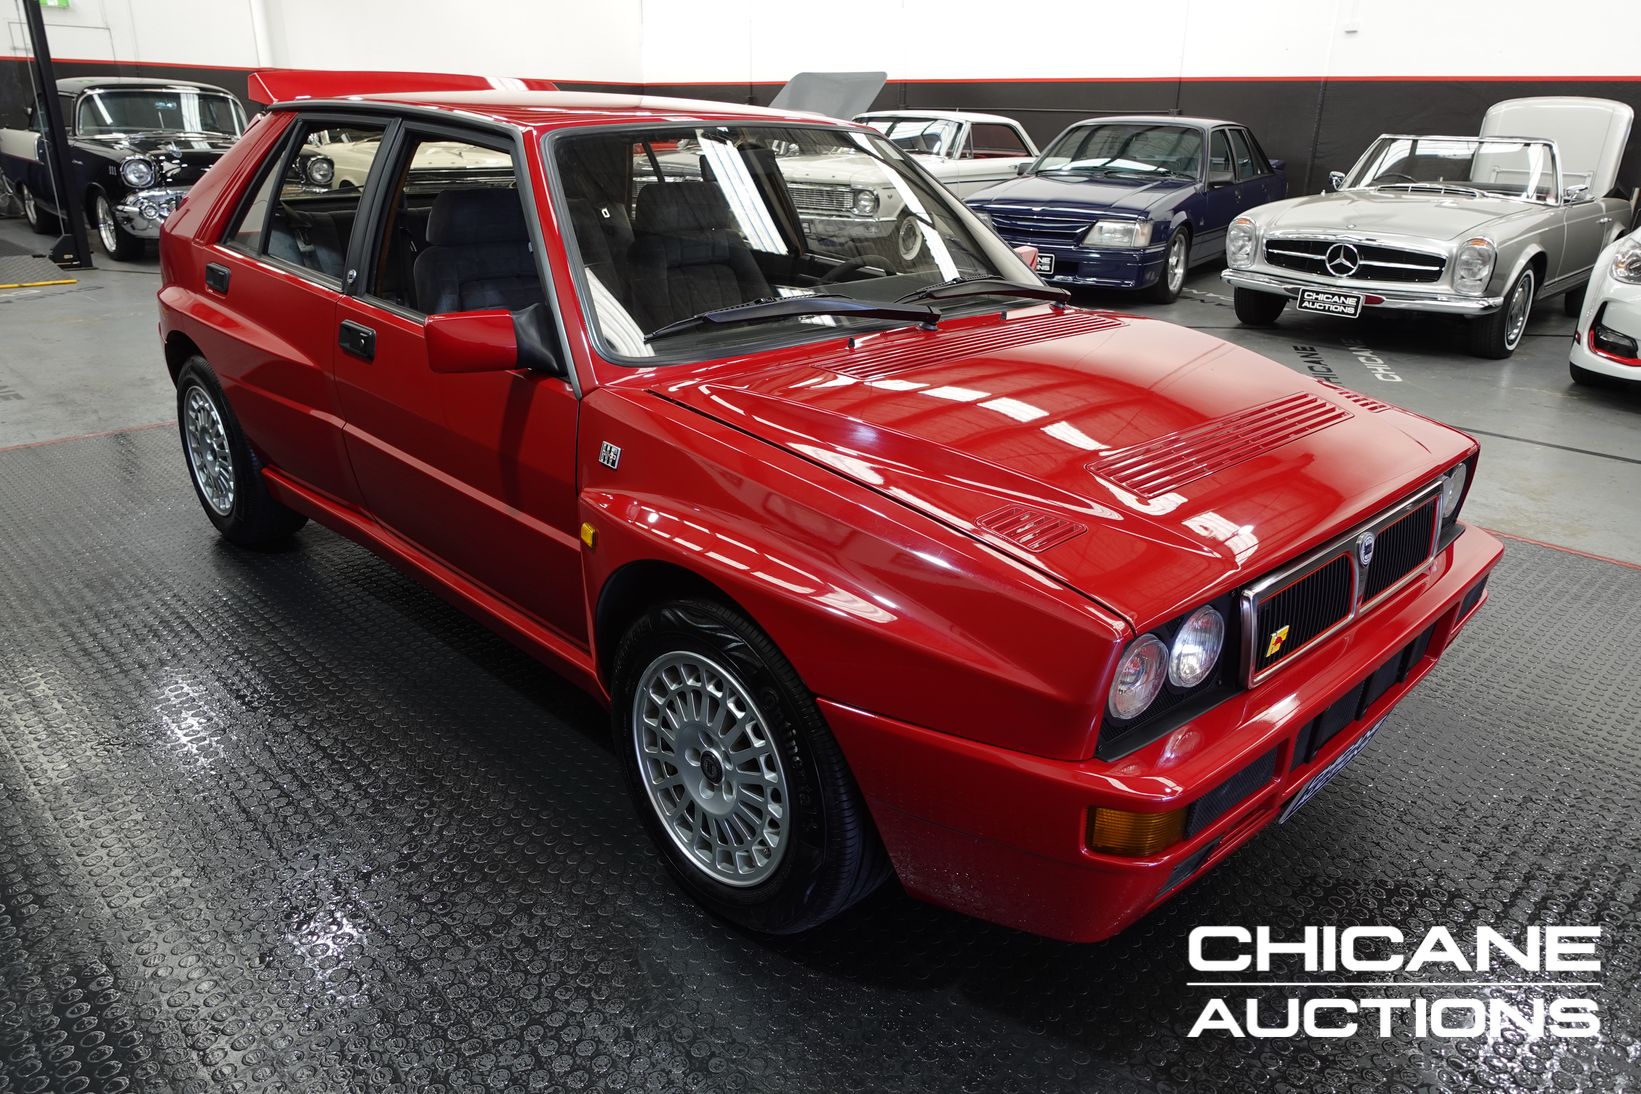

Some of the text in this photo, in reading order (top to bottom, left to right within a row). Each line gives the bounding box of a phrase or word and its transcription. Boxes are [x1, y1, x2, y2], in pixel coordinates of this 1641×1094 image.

[1304, 291, 1357, 305] CHICANE
[1302, 301, 1355, 314] AUCTIONS
[1293, 345, 1342, 385] HICANE
